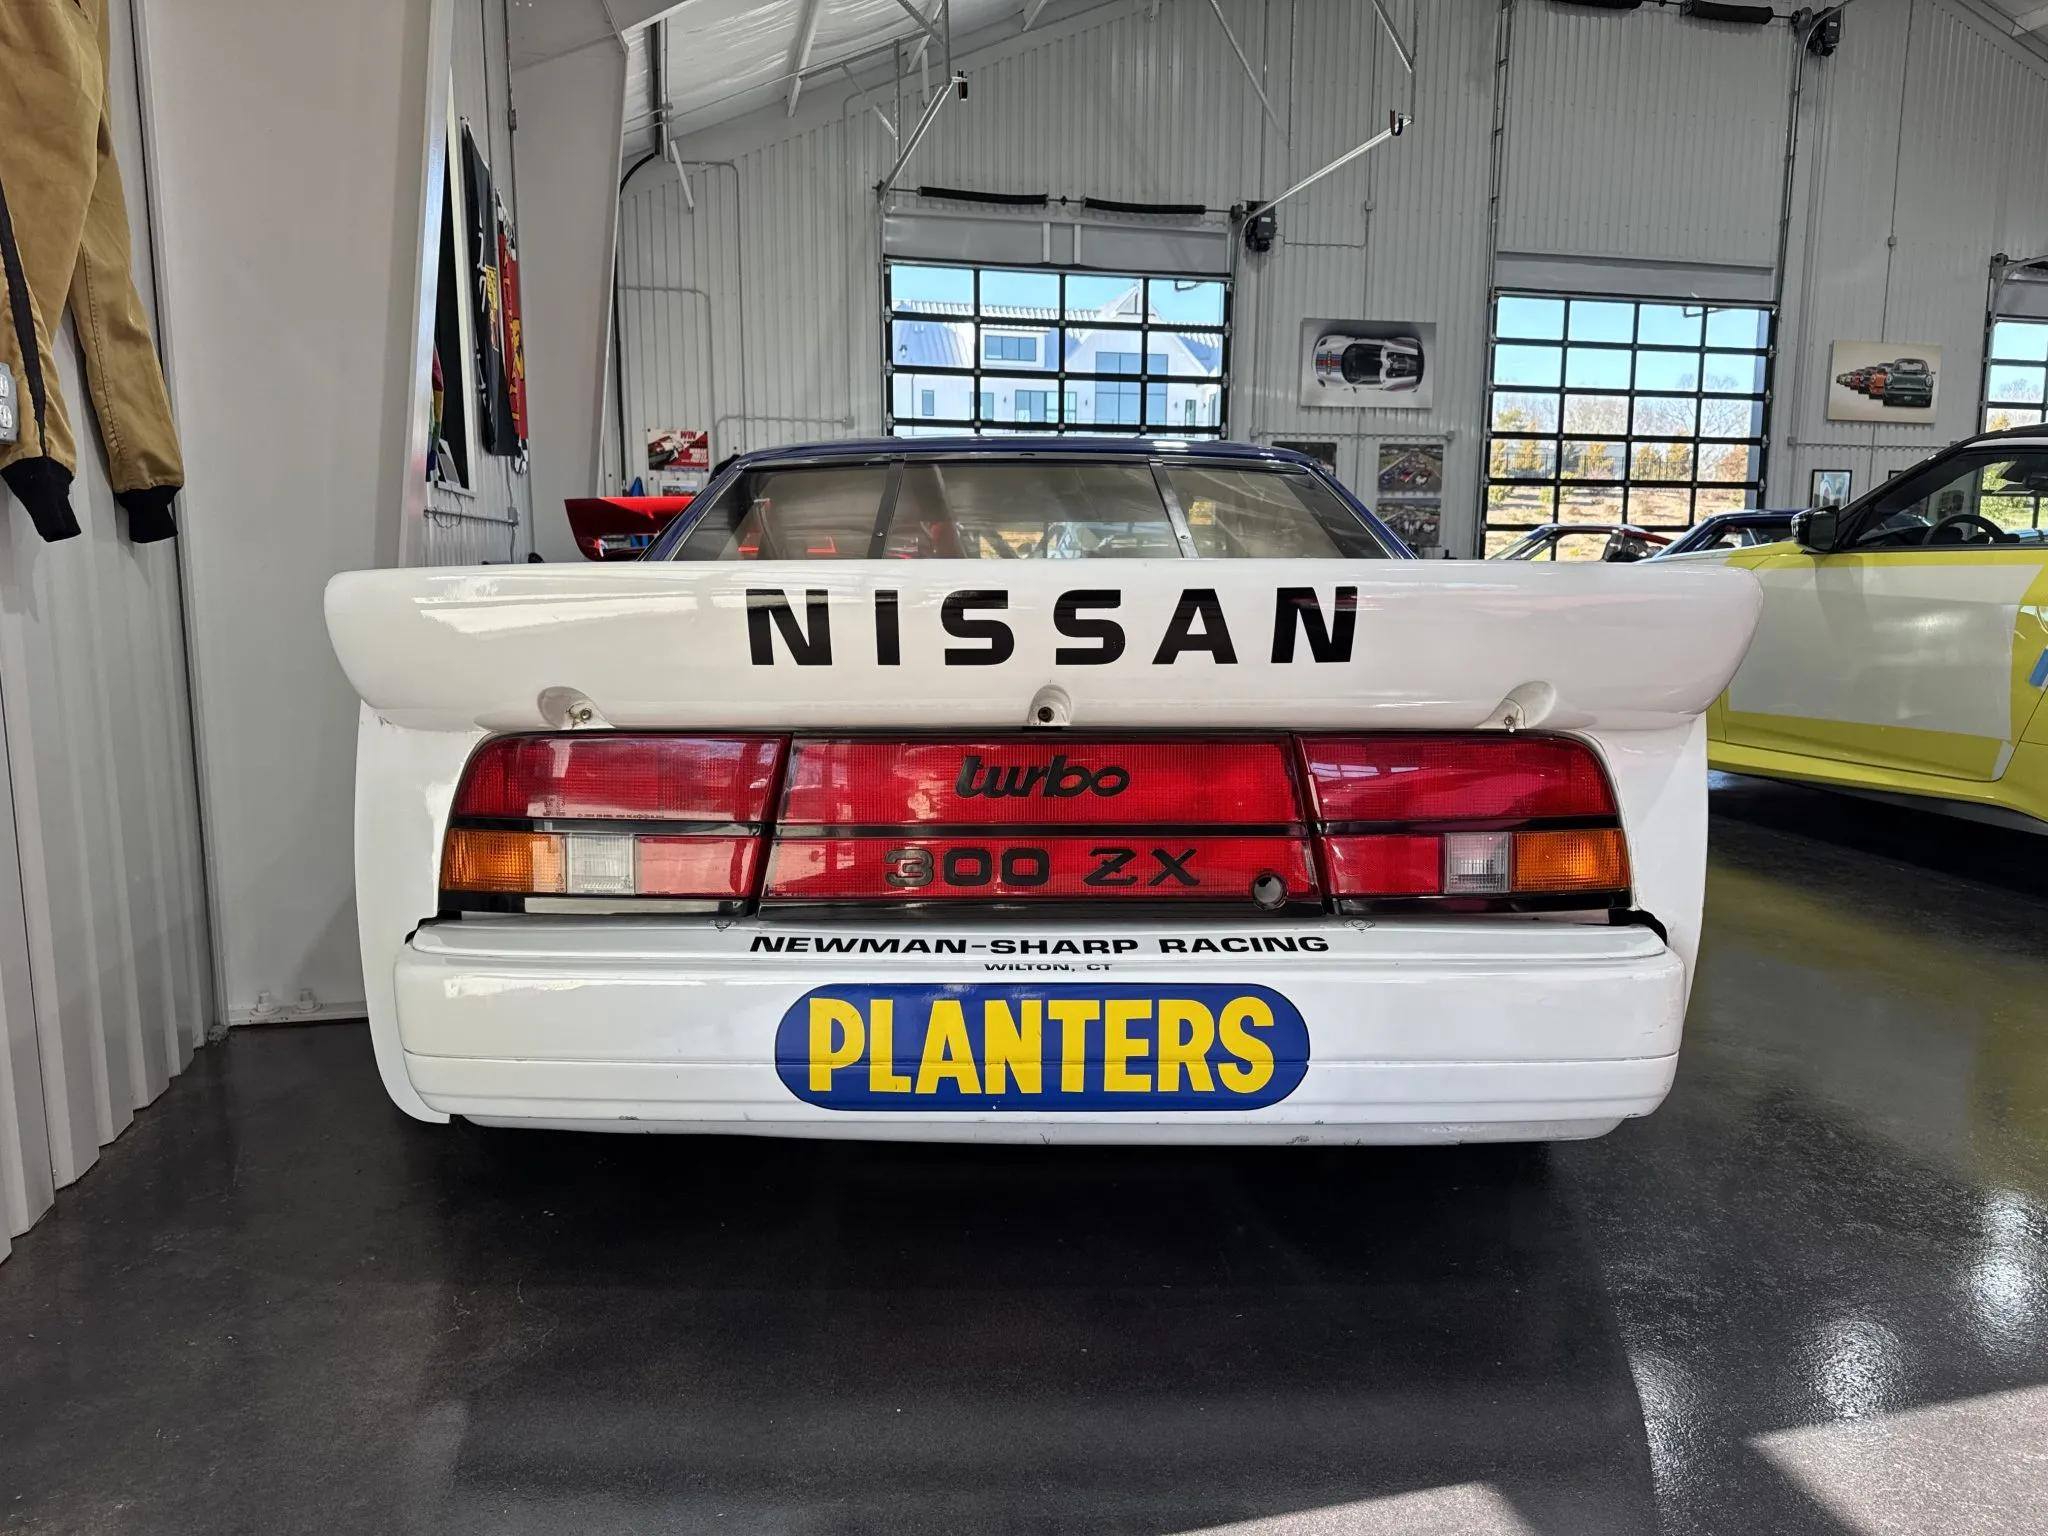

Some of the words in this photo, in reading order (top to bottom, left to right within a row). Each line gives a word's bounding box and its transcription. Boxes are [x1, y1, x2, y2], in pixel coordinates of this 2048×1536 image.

[680, 431, 697, 440] WIN
[745, 586, 1359, 666] NISSAN
[954, 755, 1131, 799] turbo
[884, 847, 1050, 888] 300
[1083, 847, 1201, 888] ZX
[749, 936, 1139, 955] NEWMAN-SHARP
[1158, 935, 1330, 954] RACING
[984, 962, 1077, 973] WILTON,
[1086, 962, 1113, 971] CT
[808, 996, 1276, 1095] PLANTERS
